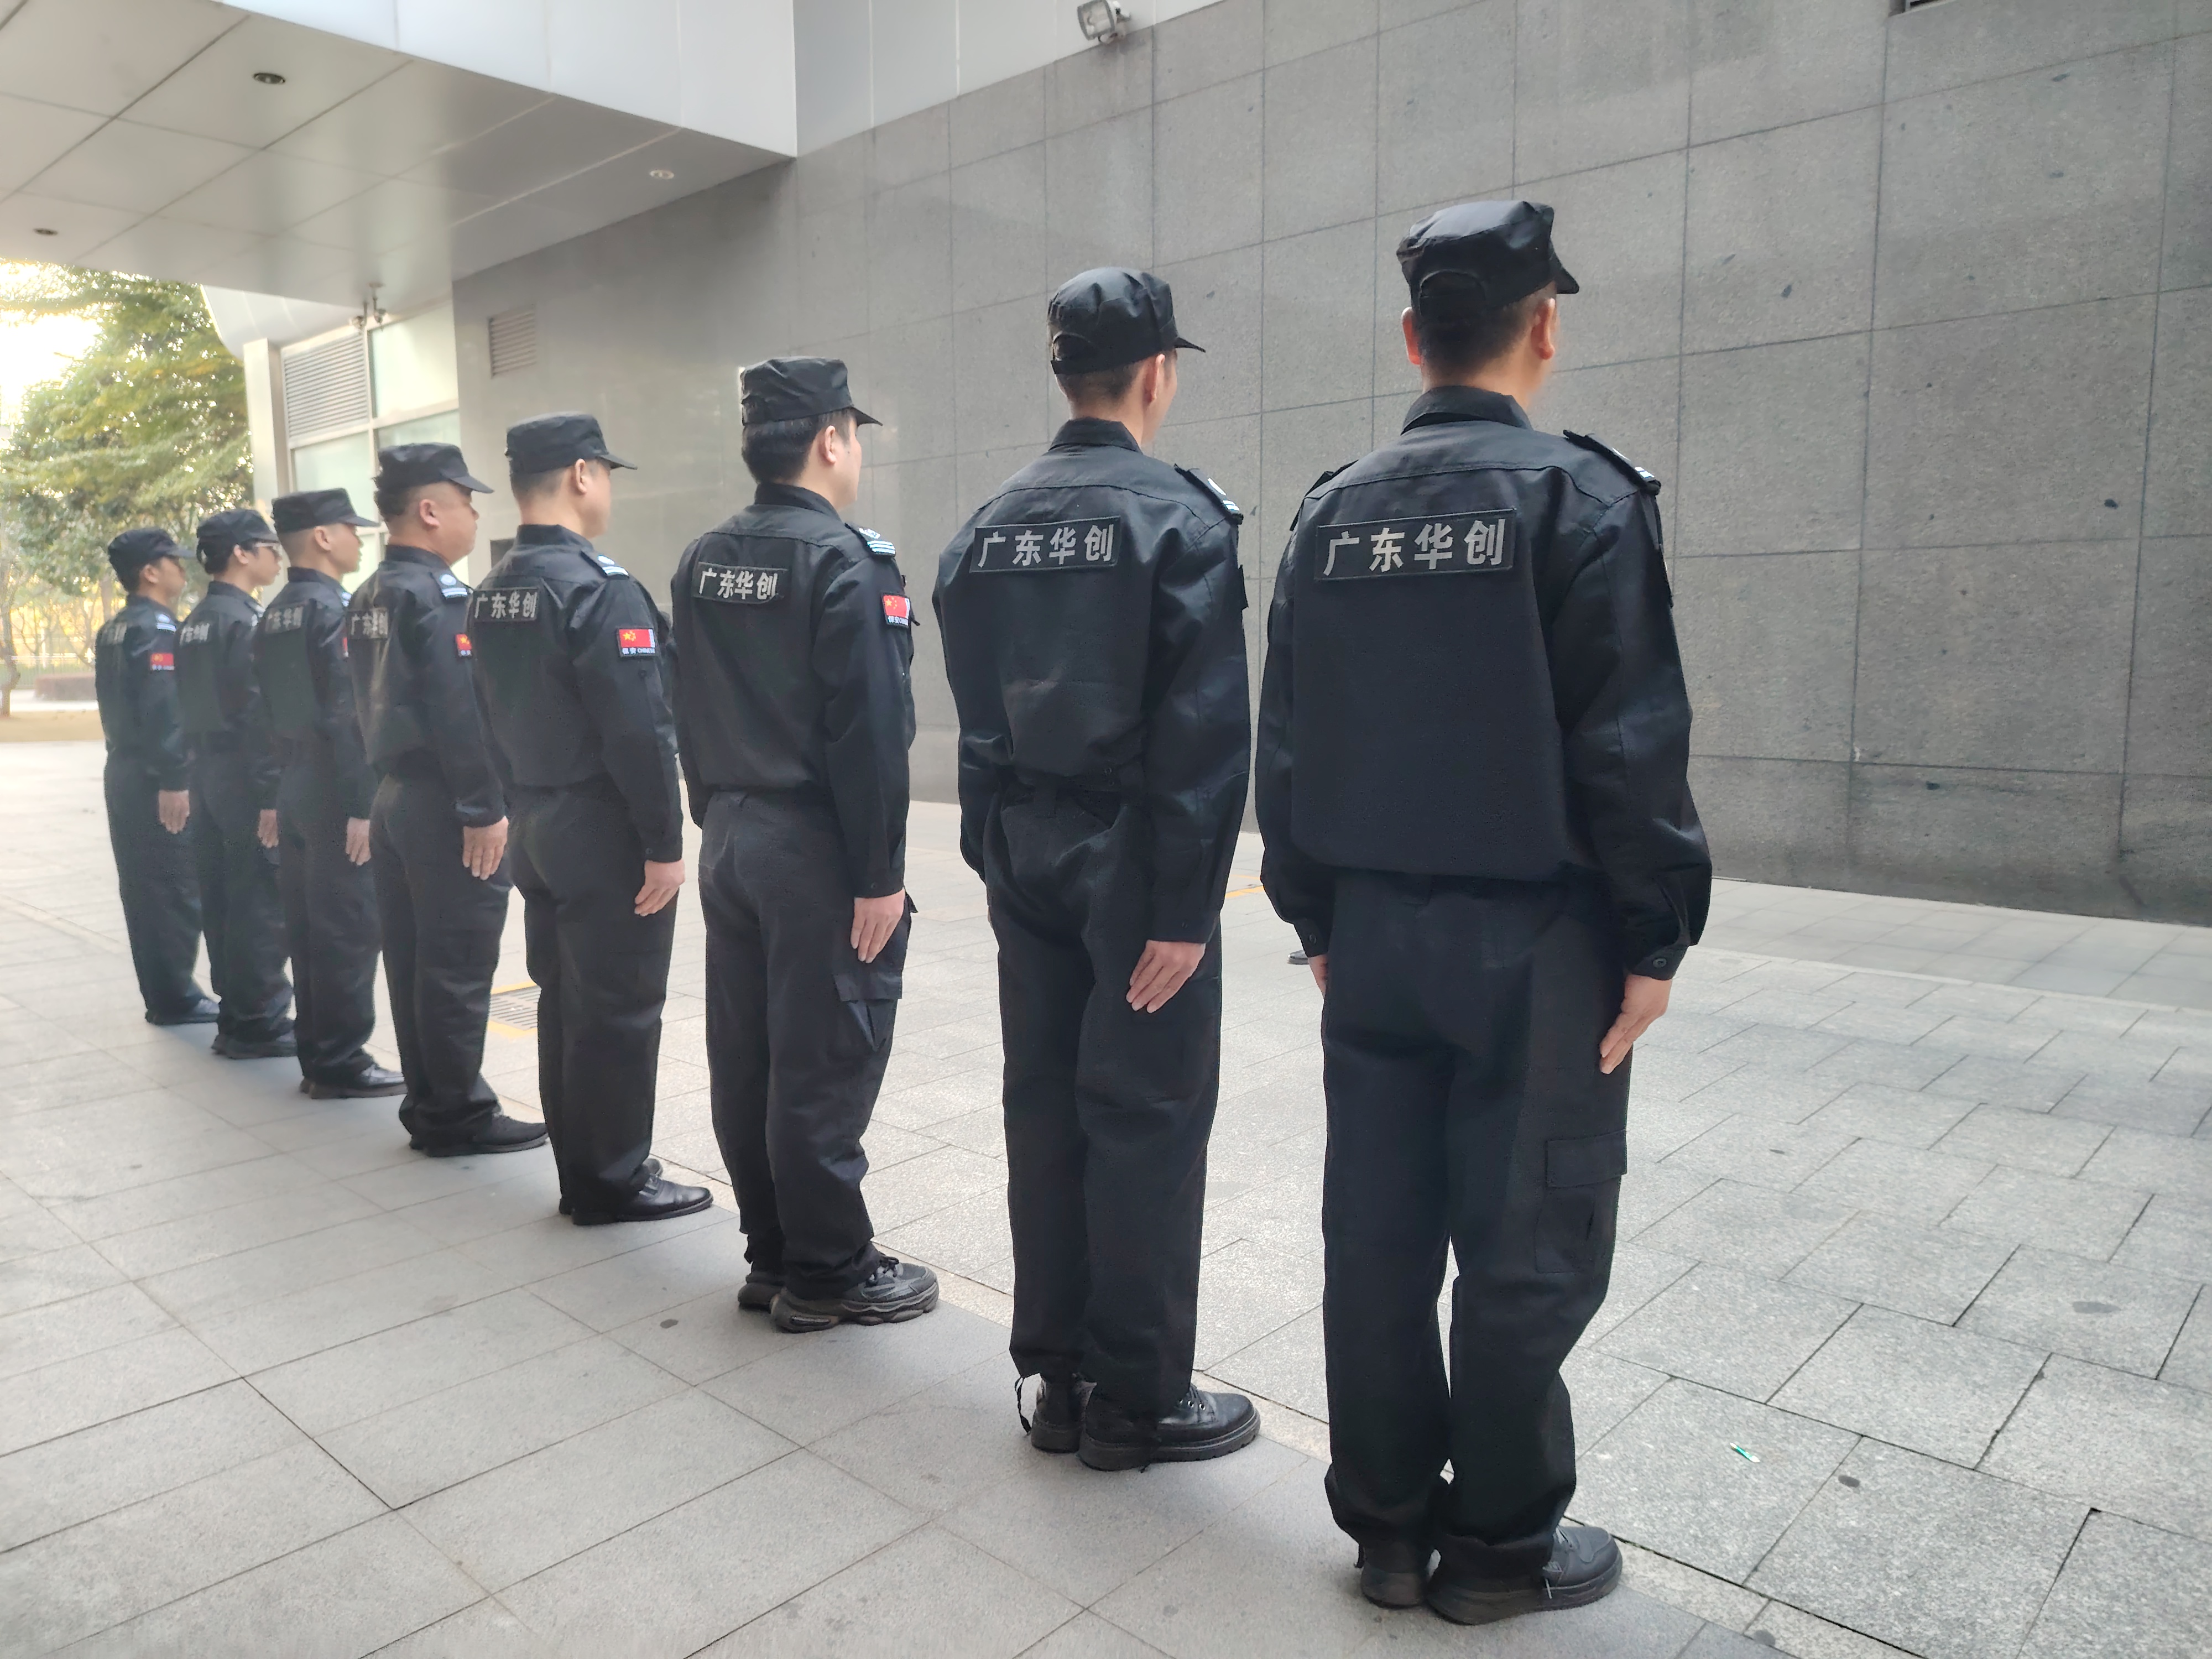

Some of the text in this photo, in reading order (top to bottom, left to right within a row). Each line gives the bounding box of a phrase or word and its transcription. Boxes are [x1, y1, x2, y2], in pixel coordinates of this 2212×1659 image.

[977, 524, 1114, 568] 广东华创
[1323, 519, 1505, 576] 广东华创
[698, 568, 777, 600] 广东华创
[474, 591, 538, 619] 广东华创
